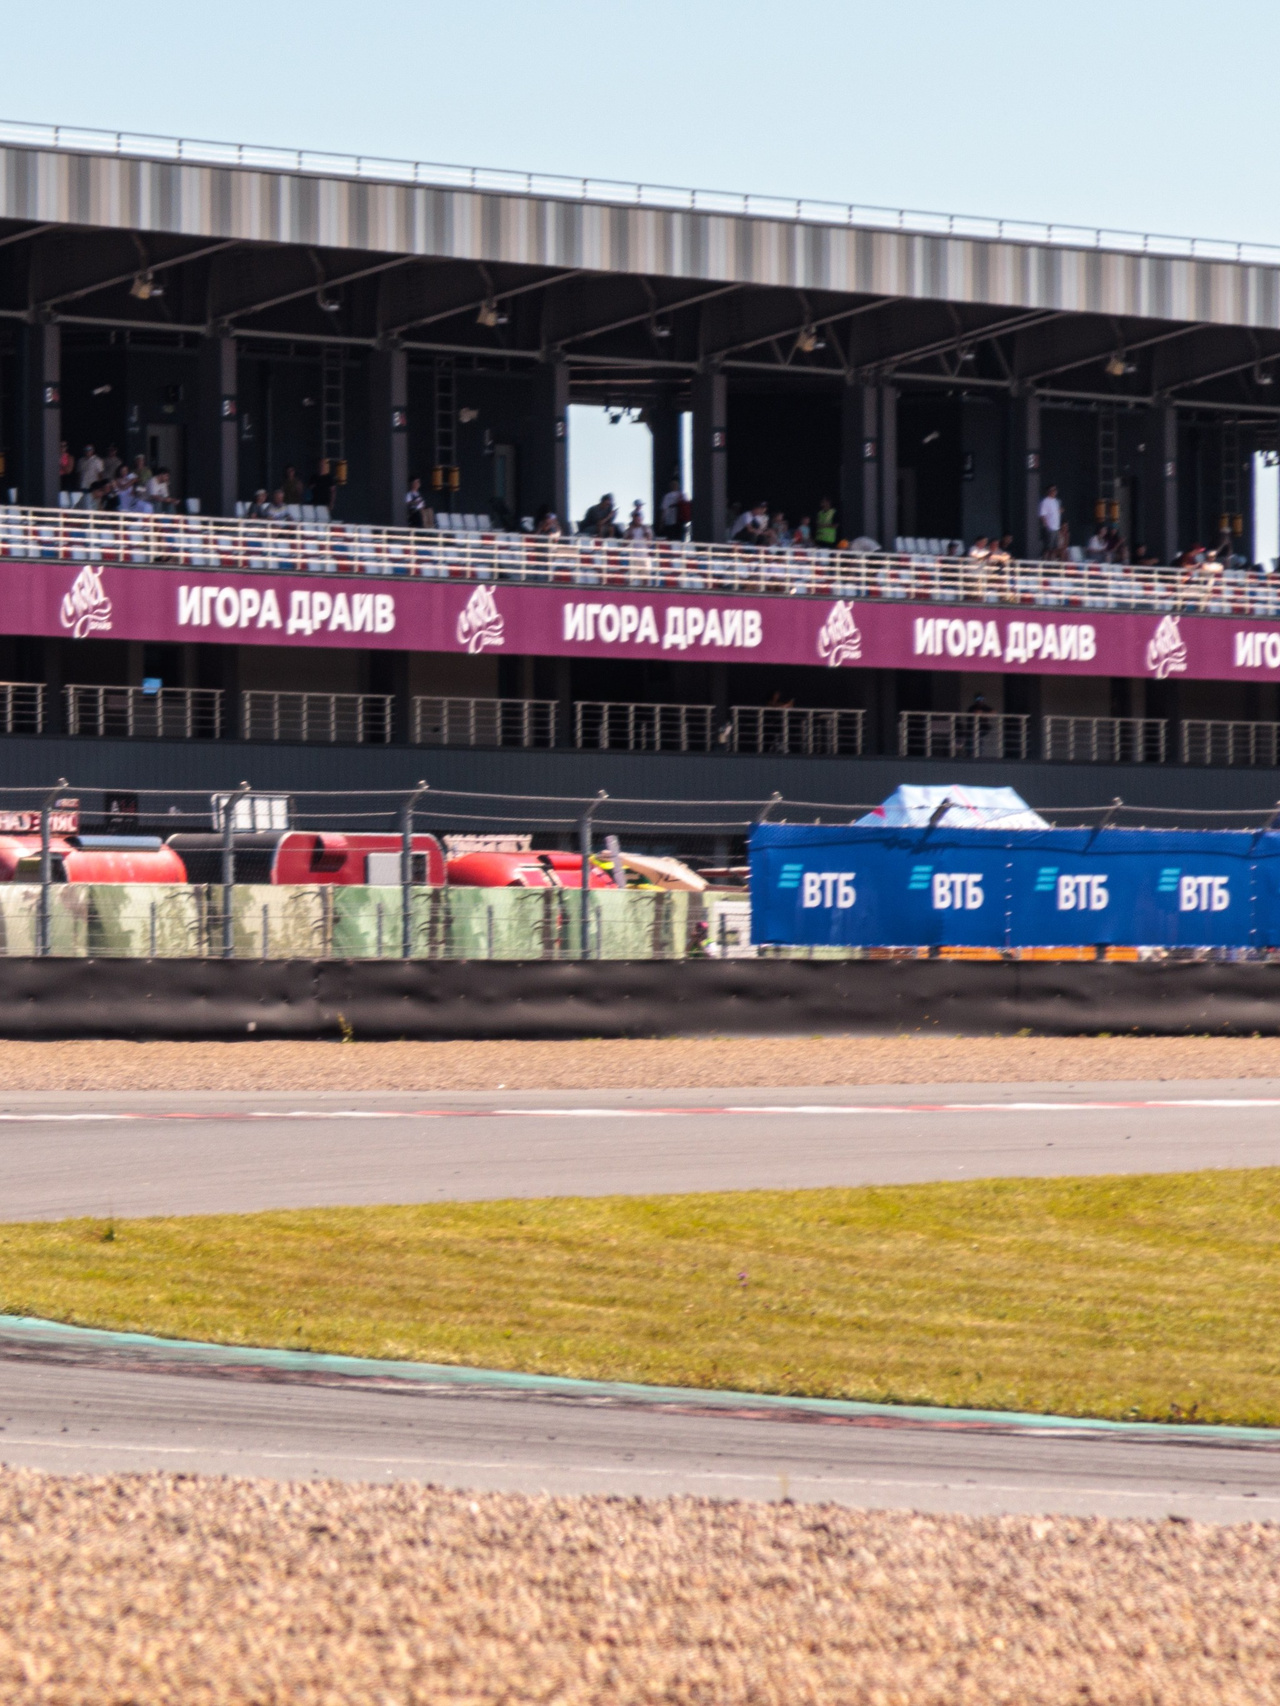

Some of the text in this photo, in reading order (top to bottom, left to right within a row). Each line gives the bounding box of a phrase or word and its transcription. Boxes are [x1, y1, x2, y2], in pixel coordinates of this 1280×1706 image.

[178, 585, 396, 636] ИГОРА ДРАЙВ
[563, 602, 763, 650] ИГОРА ДРАЙВ
[914, 617, 1096, 664] ИГОРА ДРАЙВ
[802, 872, 856, 909] ВТБ
[932, 873, 985, 910] ВТБ
[1056, 874, 1109, 911] ВТБ
[1179, 875, 1230, 911] ВТБ
